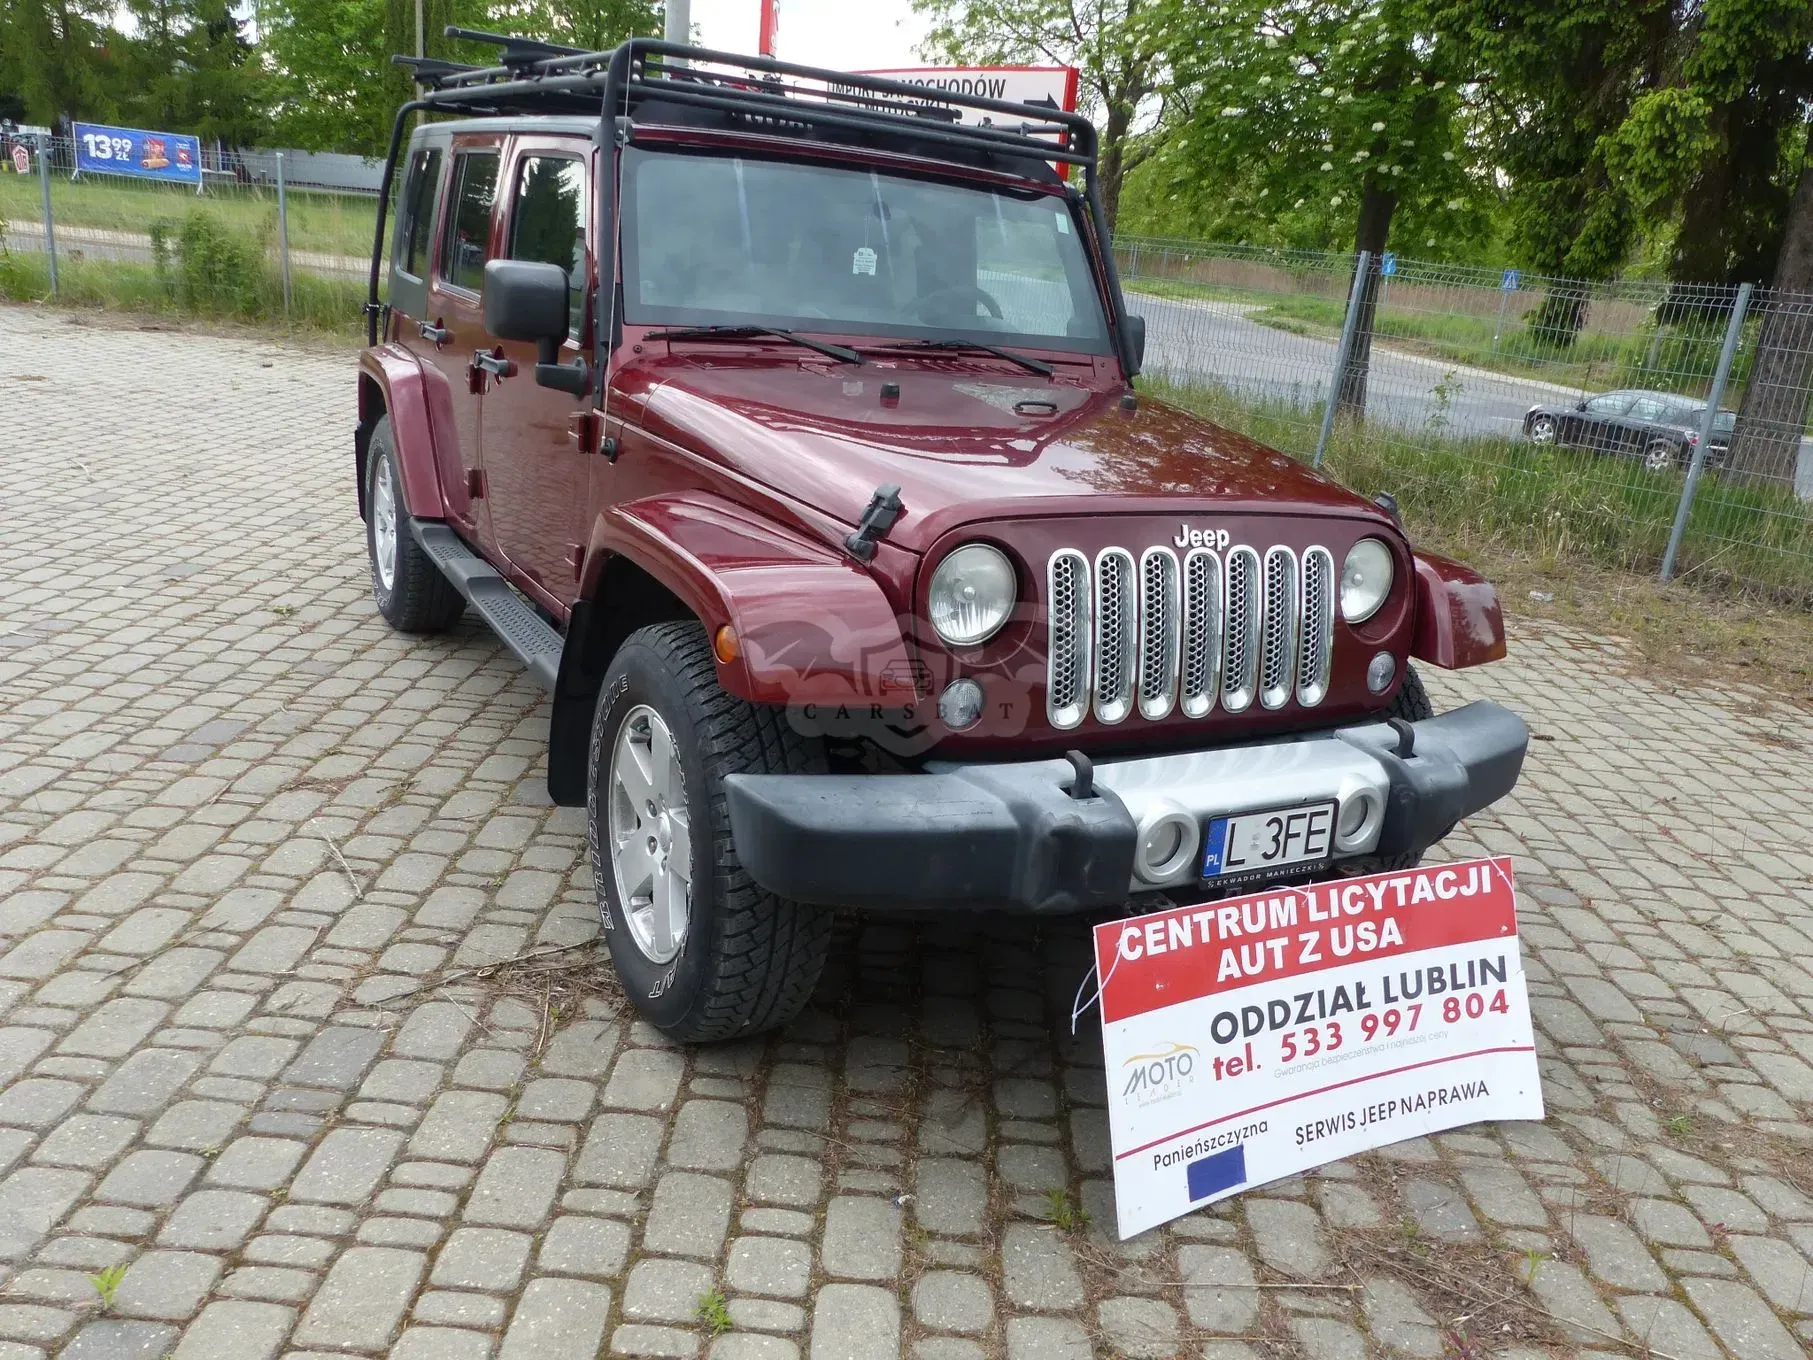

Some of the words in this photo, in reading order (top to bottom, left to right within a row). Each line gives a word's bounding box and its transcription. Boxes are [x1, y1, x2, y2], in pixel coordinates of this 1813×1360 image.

[1173, 524, 1230, 551] Jeep
[1206, 854, 1220, 867] PL
[1226, 823, 1245, 867] L
[1262, 810, 1329, 860] 3FE
[1217, 873, 1261, 886] EKWADOR
[1119, 895, 1298, 962] CENTRUM
[1307, 864, 1492, 922] LICYTACJI
[1216, 938, 1289, 983] AUT
[1298, 933, 1321, 965] Z
[1330, 917, 1403, 959] USA
[1210, 981, 1371, 1045] ODDZIAŁ
[1383, 955, 1507, 1005] LUBLIN
[1213, 1042, 1261, 1081] tel.
[1281, 1022, 1342, 1063] 533
[1361, 1004, 1422, 1042] 997
[1443, 989, 1509, 1025] 804
[1123, 1053, 1192, 1097] MOTO
[1295, 1113, 1356, 1145] SERWIS
[1359, 1100, 1397, 1129] JEEP
[1401, 1080, 1489, 1114] NAPRAWA
[1153, 1119, 1268, 1171] Panieńszczyzna
